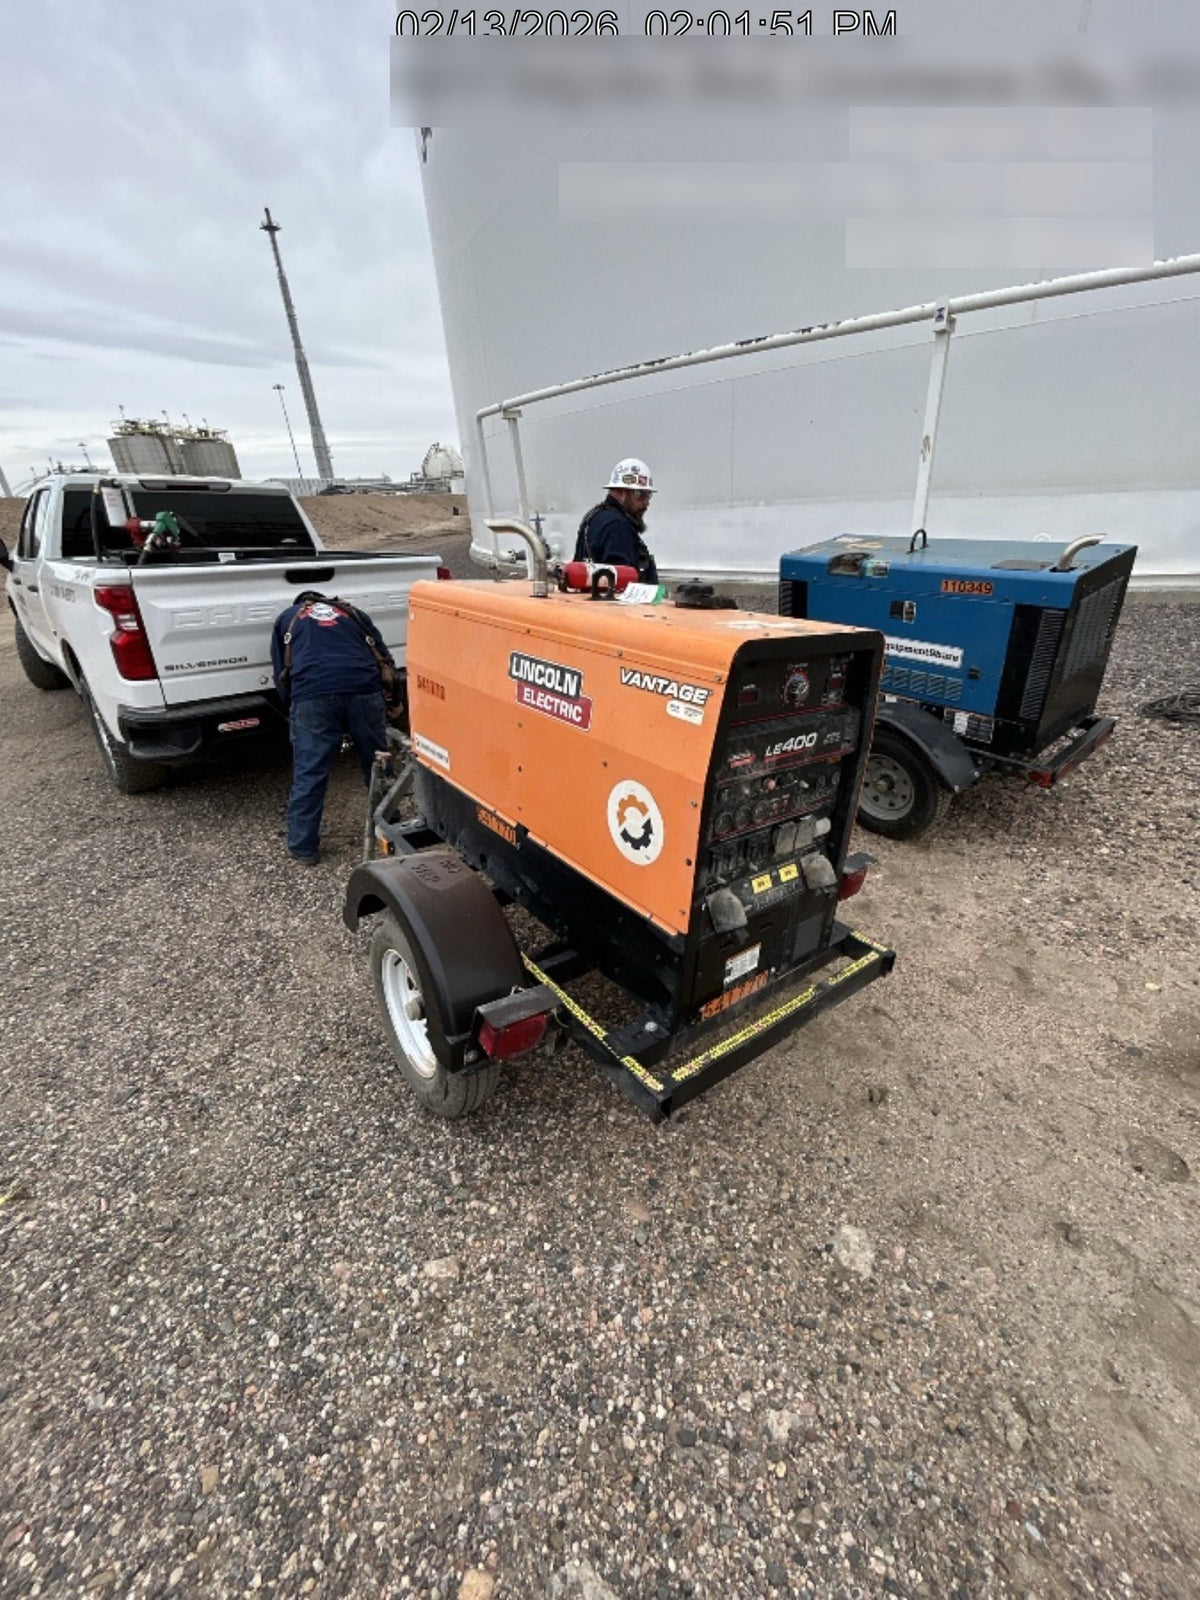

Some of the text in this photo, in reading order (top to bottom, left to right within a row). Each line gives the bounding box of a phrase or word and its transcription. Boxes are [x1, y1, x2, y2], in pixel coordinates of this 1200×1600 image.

[942, 580, 993, 595] 110349
[885, 642, 960, 662] quipmentShare
[510, 655, 580, 698] LINCOLN
[620, 666, 709, 706] VANTAGE
[522, 687, 583, 723] ELECTRIC
[765, 731, 818, 757] LE400
